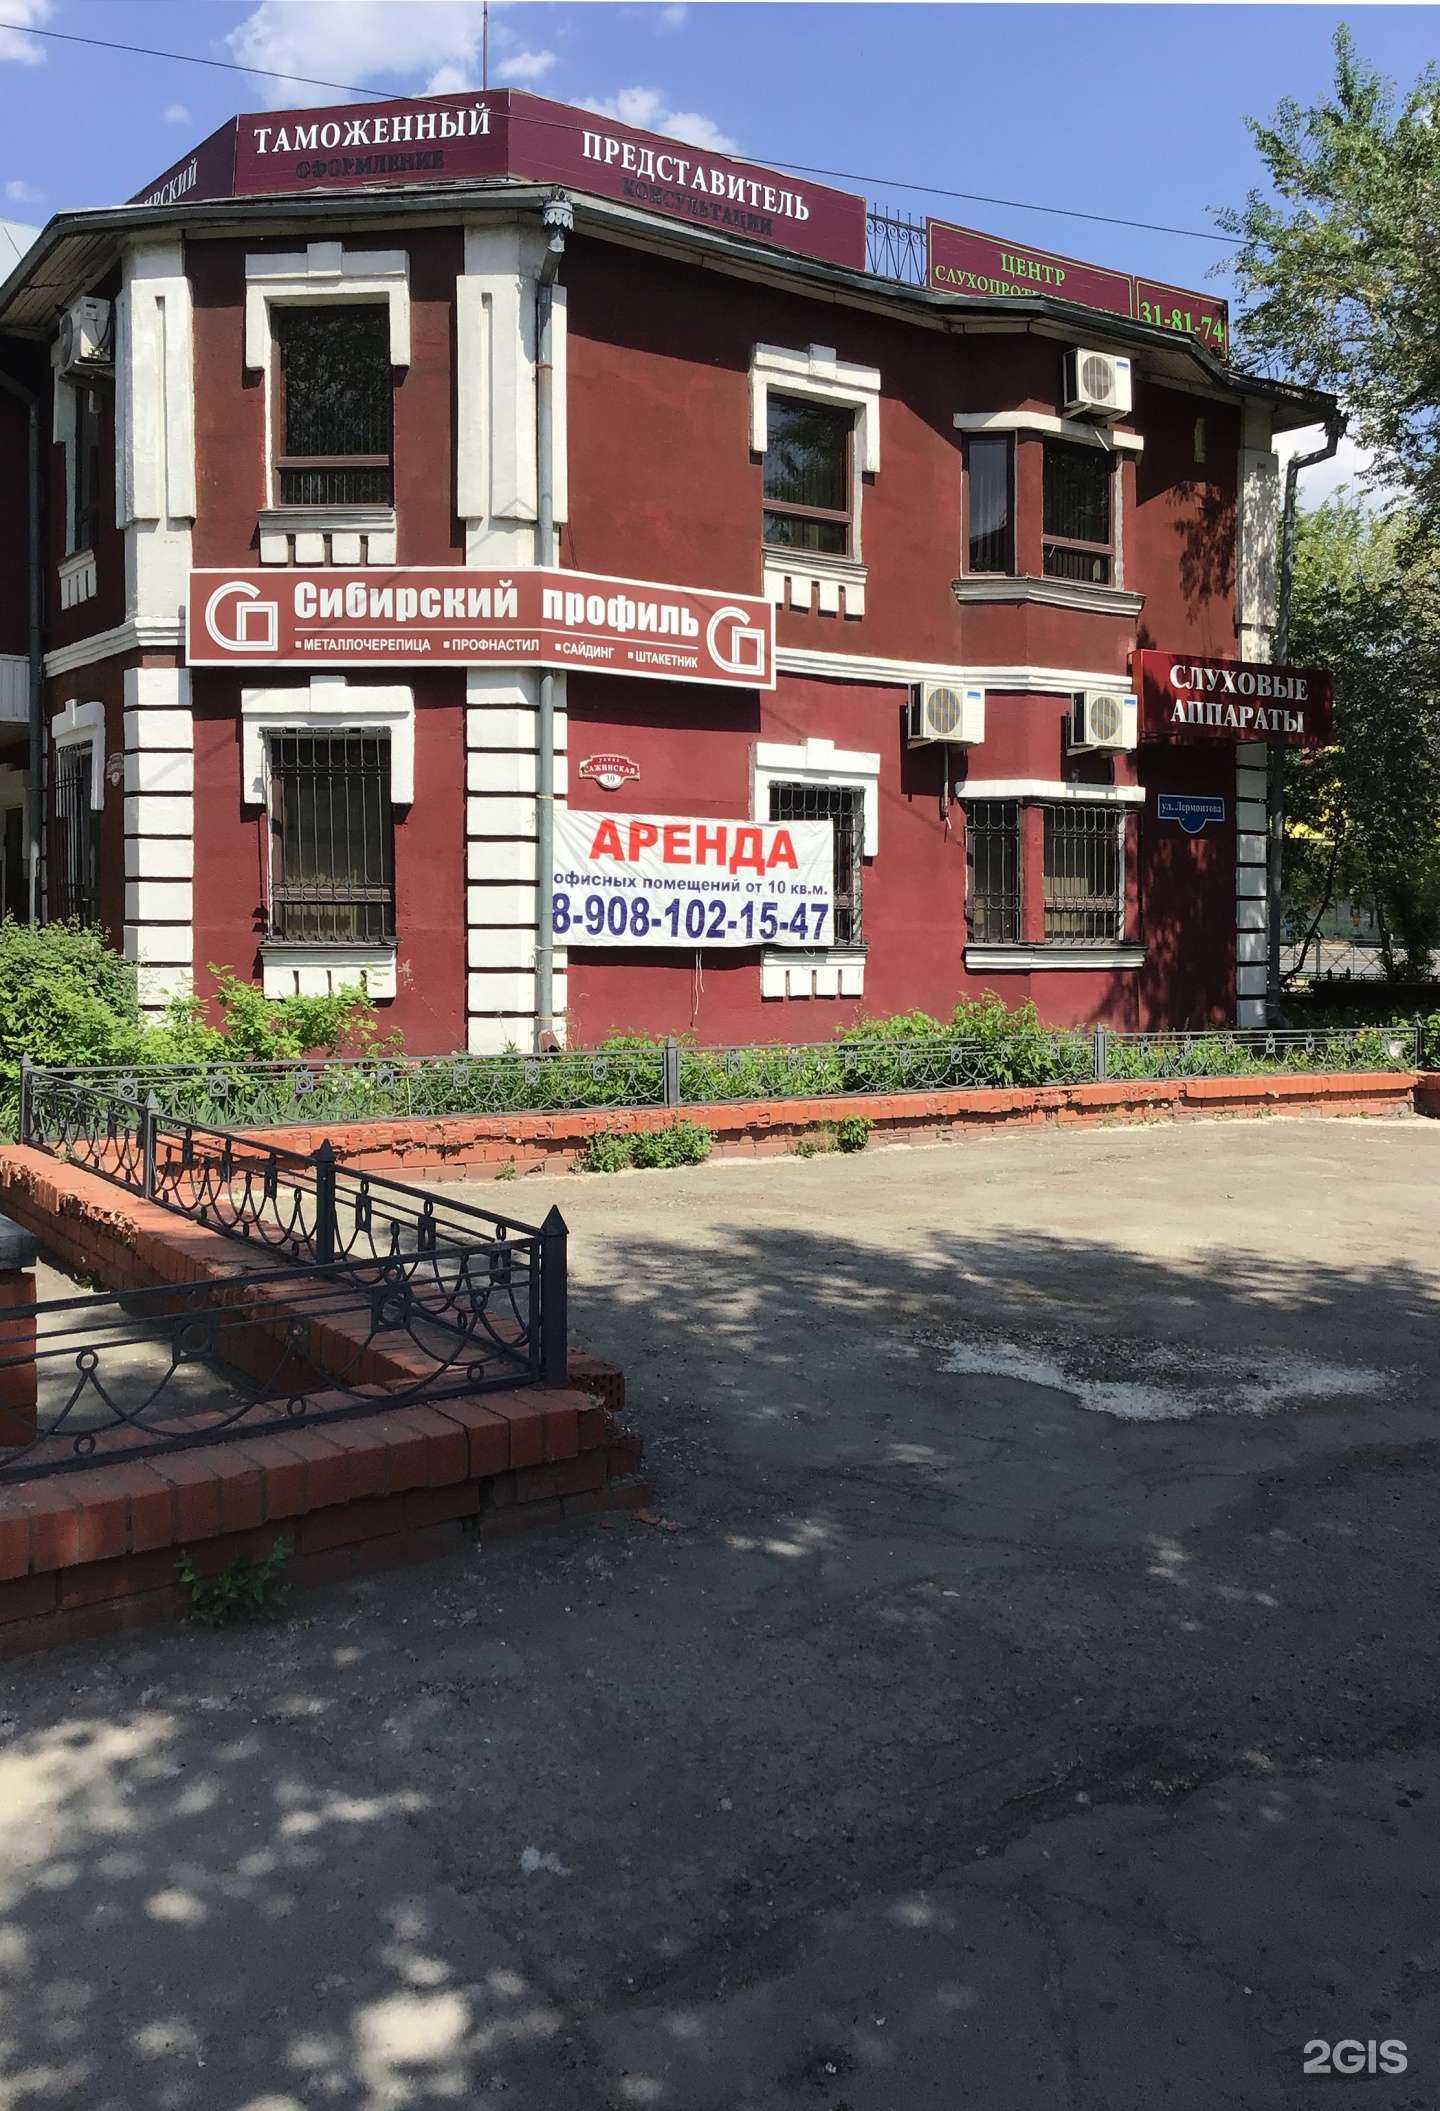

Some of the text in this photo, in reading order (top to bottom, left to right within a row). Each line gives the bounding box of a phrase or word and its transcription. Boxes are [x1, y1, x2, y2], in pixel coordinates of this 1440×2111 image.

[253, 102, 492, 155] ТАМОЖЕННЫЙ
[581, 130, 811, 222] ПРЕДСТАВИТЕЛЬ
[1000, 252, 1067, 288] ЦЕНТР
[1139, 301, 1225, 343] 31-81-74
[294, 579, 700, 638] Сибирский профиль
[304, 638, 699, 670] МЕТАЛЛОЧЕРЕПИЦА ПРОФНАСТИЛ САЙДИНГ ШТАКЕТНИК
[1169, 664, 1309, 702] СЛУХОВЫЕ
[1169, 698, 1305, 733] АППАРАТЫ
[1175, 800, 1222, 815] Лермонтова
[588, 819, 799, 877] АРЕНДА
[553, 869, 829, 896] офисных помещений от 10 кв.м.
[552, 892, 829, 940] 8-908-102-15-47
